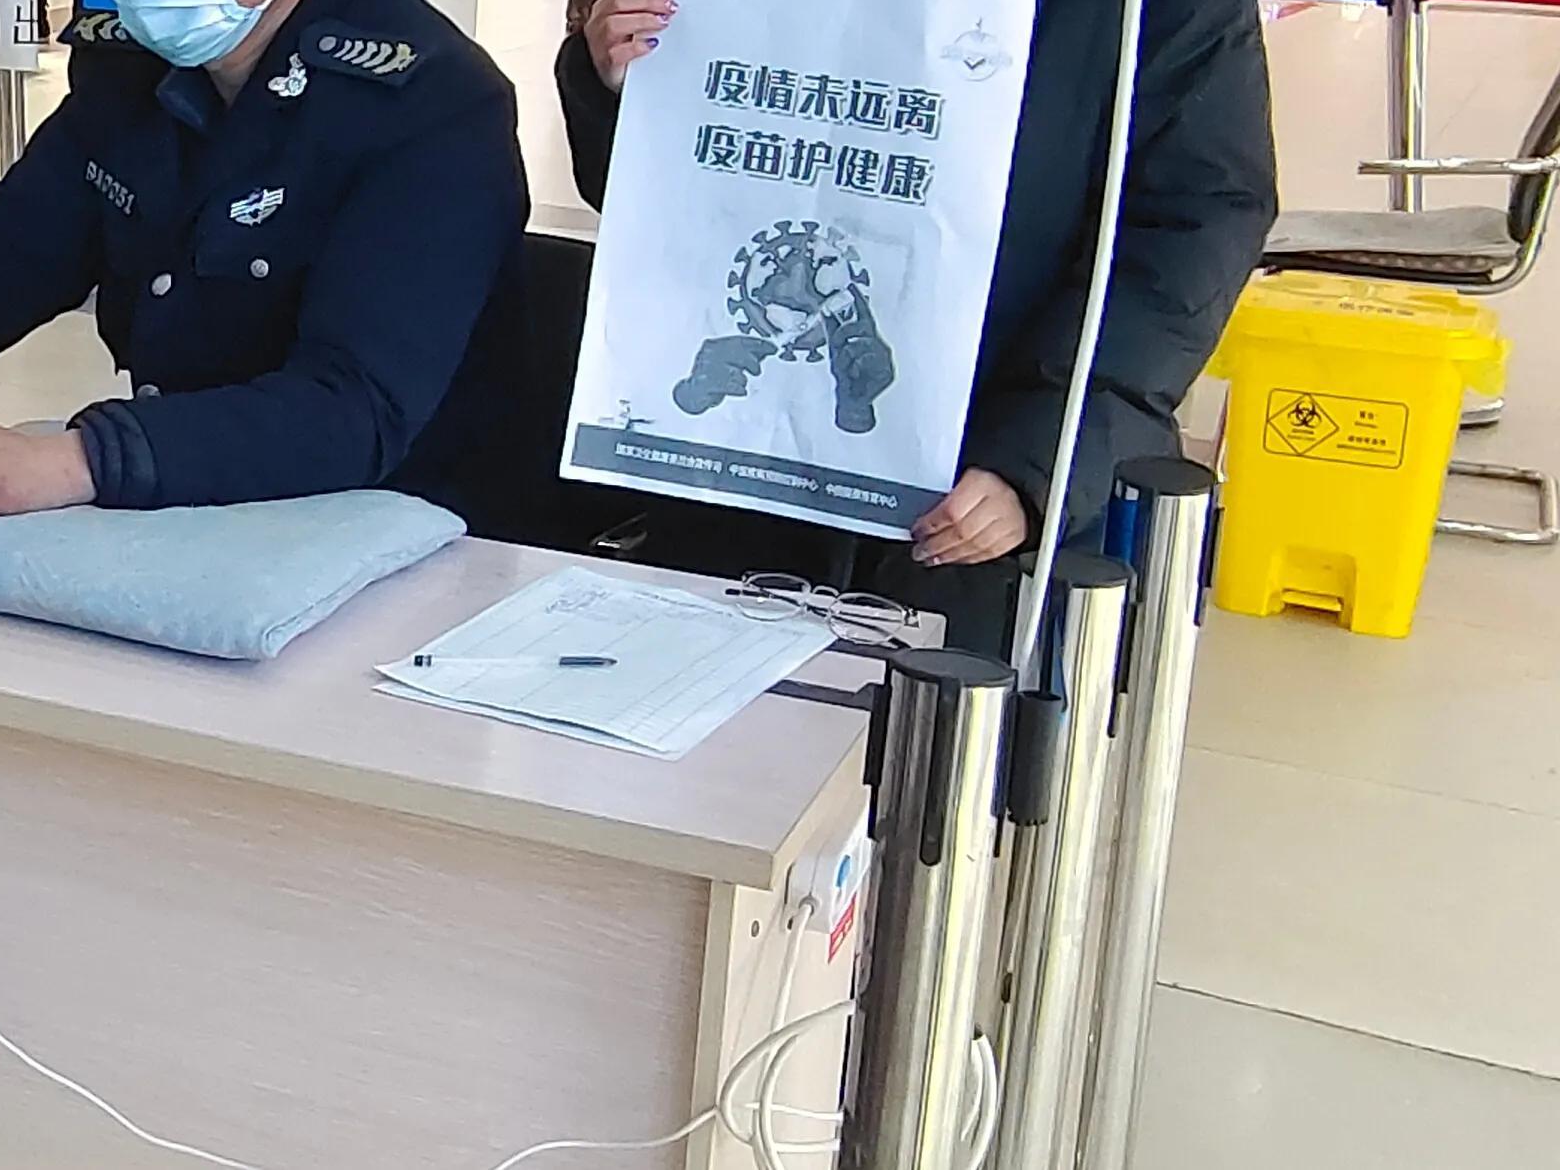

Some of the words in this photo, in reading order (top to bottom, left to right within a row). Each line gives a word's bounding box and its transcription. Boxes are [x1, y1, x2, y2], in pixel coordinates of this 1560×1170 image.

[704, 59, 944, 138] 疫情未远离
[694, 124, 933, 204] 疫苗护健康
